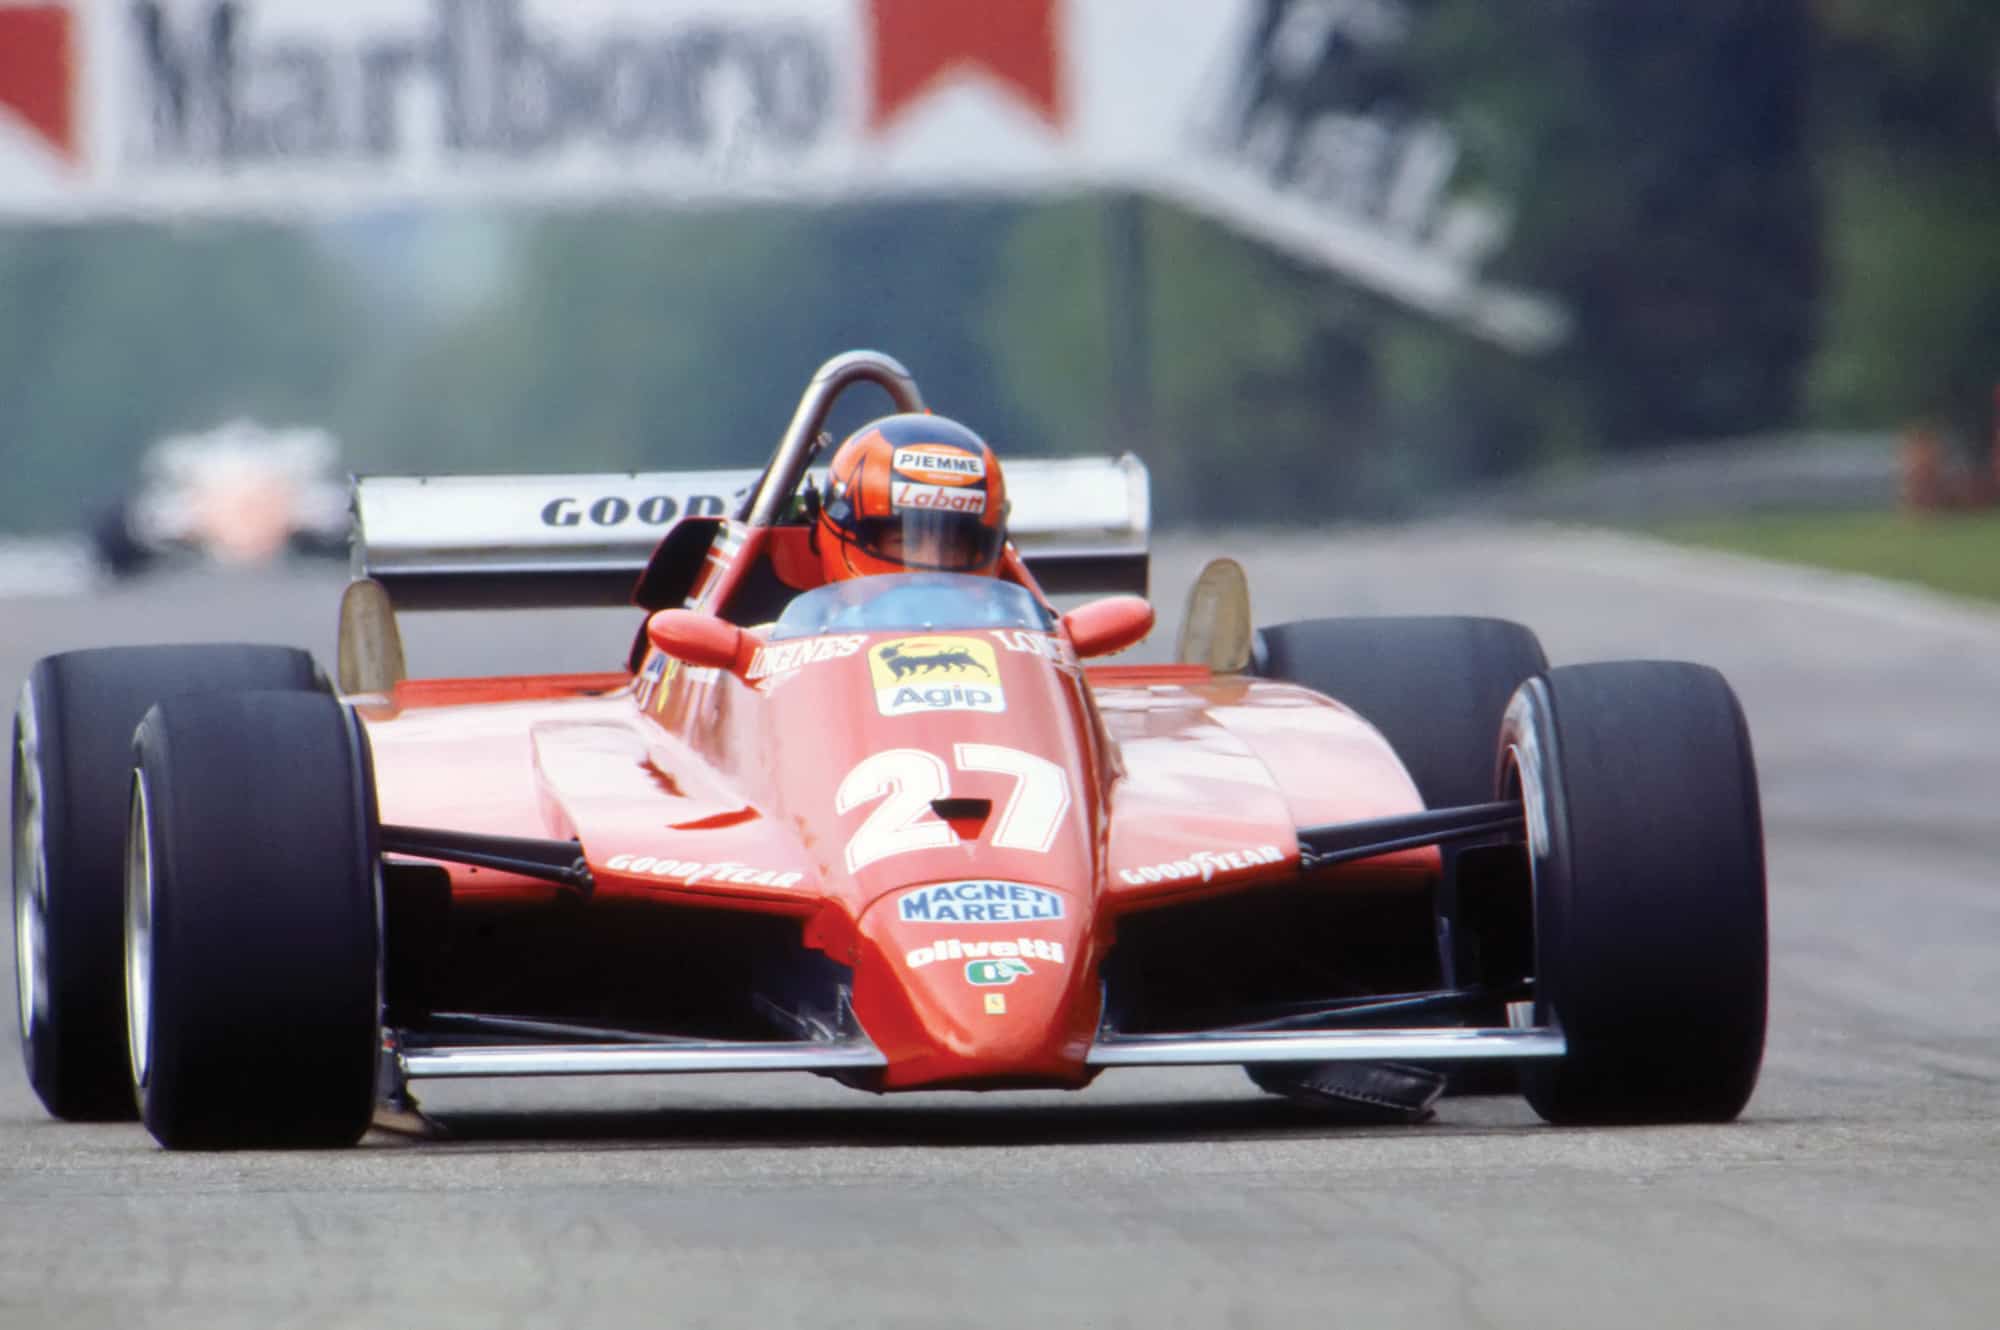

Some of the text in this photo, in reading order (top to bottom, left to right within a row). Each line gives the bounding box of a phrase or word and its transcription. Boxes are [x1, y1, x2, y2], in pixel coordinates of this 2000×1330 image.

[900, 454, 981, 473] PIEMME
[892, 684, 993, 707] Agip
[835, 742, 1072, 875] 27
[903, 883, 1060, 919] MAGNETI
[903, 892, 1060, 921] MARELLI
[905, 937, 1065, 969] olivetti
